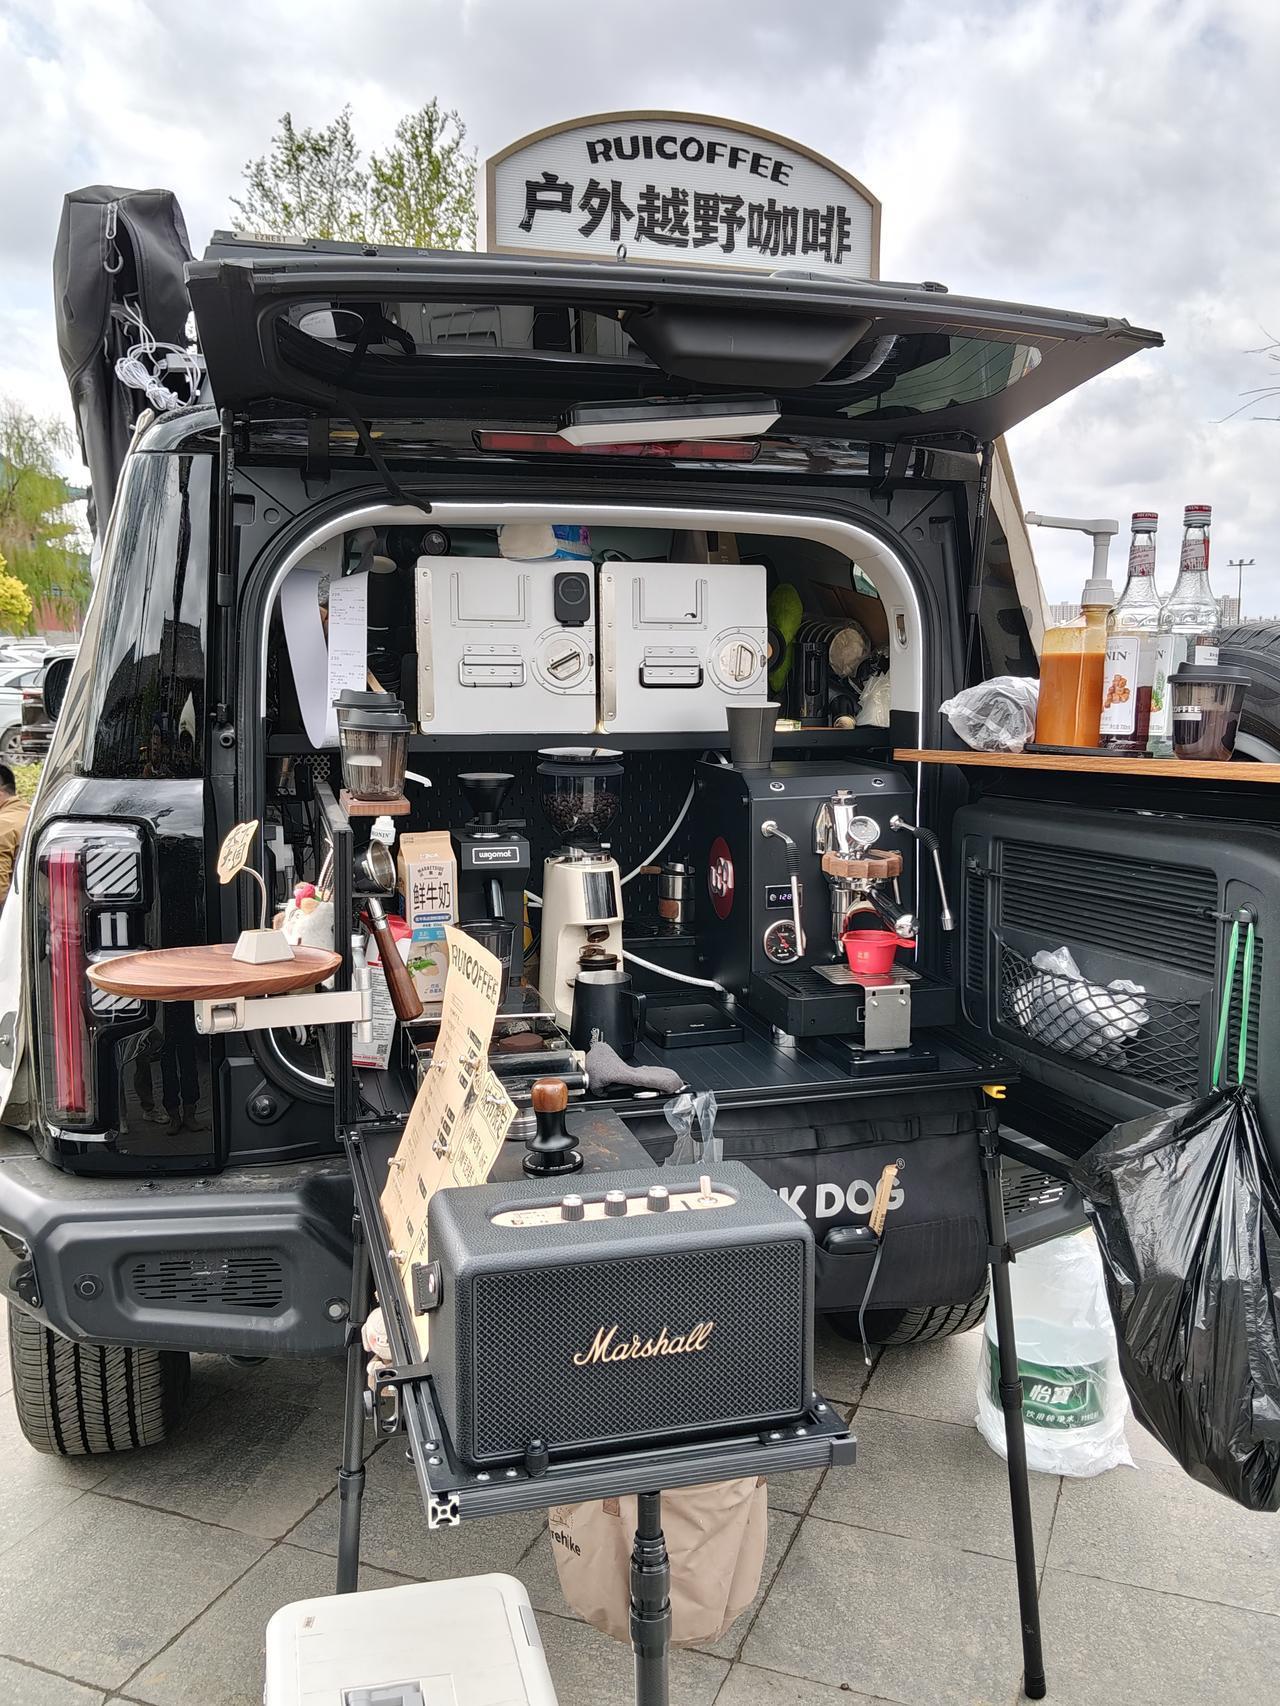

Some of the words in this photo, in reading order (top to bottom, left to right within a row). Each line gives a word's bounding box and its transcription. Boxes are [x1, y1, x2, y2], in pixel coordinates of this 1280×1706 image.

[586, 135, 794, 187] RUICOFFEE
[518, 171, 852, 265] 户外越野咖啡
[1172, 705, 1201, 713] OFFEE
[478, 849, 512, 860] wigomat
[413, 881, 451, 910] 鲜牛奶
[450, 943, 500, 1006] RUICOFFEE
[815, 1175, 905, 1219] DOG
[573, 1321, 715, 1366] Marshall
